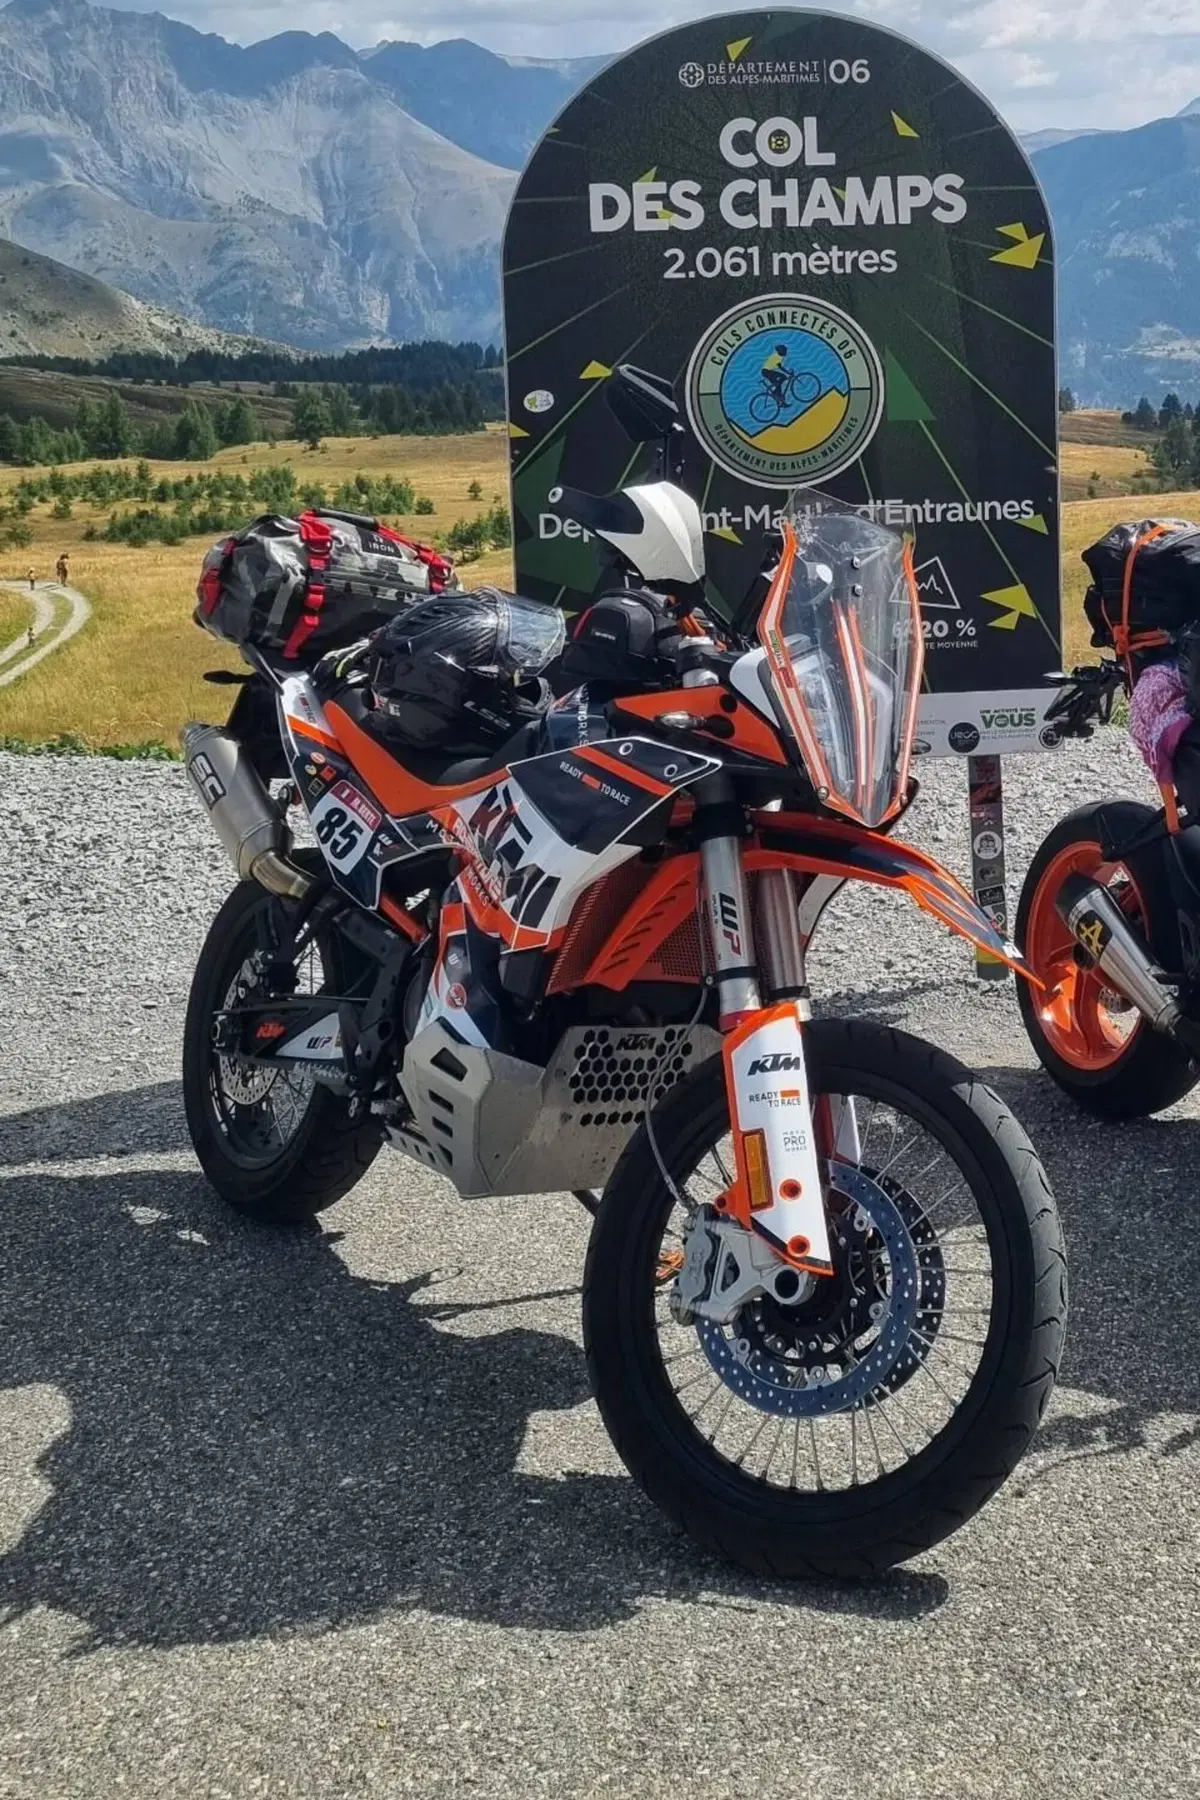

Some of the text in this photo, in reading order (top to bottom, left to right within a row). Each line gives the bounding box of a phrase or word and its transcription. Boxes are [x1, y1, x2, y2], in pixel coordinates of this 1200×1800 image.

[707, 59, 820, 75] DÉPARTEMENT
[829, 59, 870, 84] 06
[708, 73, 820, 85] DES ALPES-MARITIMES
[719, 116, 836, 168] COL
[588, 173, 967, 233] DES CHAMPS
[663, 243, 898, 280] 2.061 mètres
[711, 310, 857, 367] COLS CONNECTÉS 06
[955, 618, 977, 637] %
[937, 640, 979, 650] MOYENNE
[980, 712, 1037, 730] VOUS
[560, 761, 584, 779] READY
[610, 787, 631, 806] RACE
[316, 807, 364, 860] 85
[616, 1033, 656, 1050] KTM
[747, 1053, 801, 1076] KTM
[749, 1091, 779, 1103] READY
[768, 1098, 801, 1108] TO RACE
[783, 1136, 806, 1147] PRO
